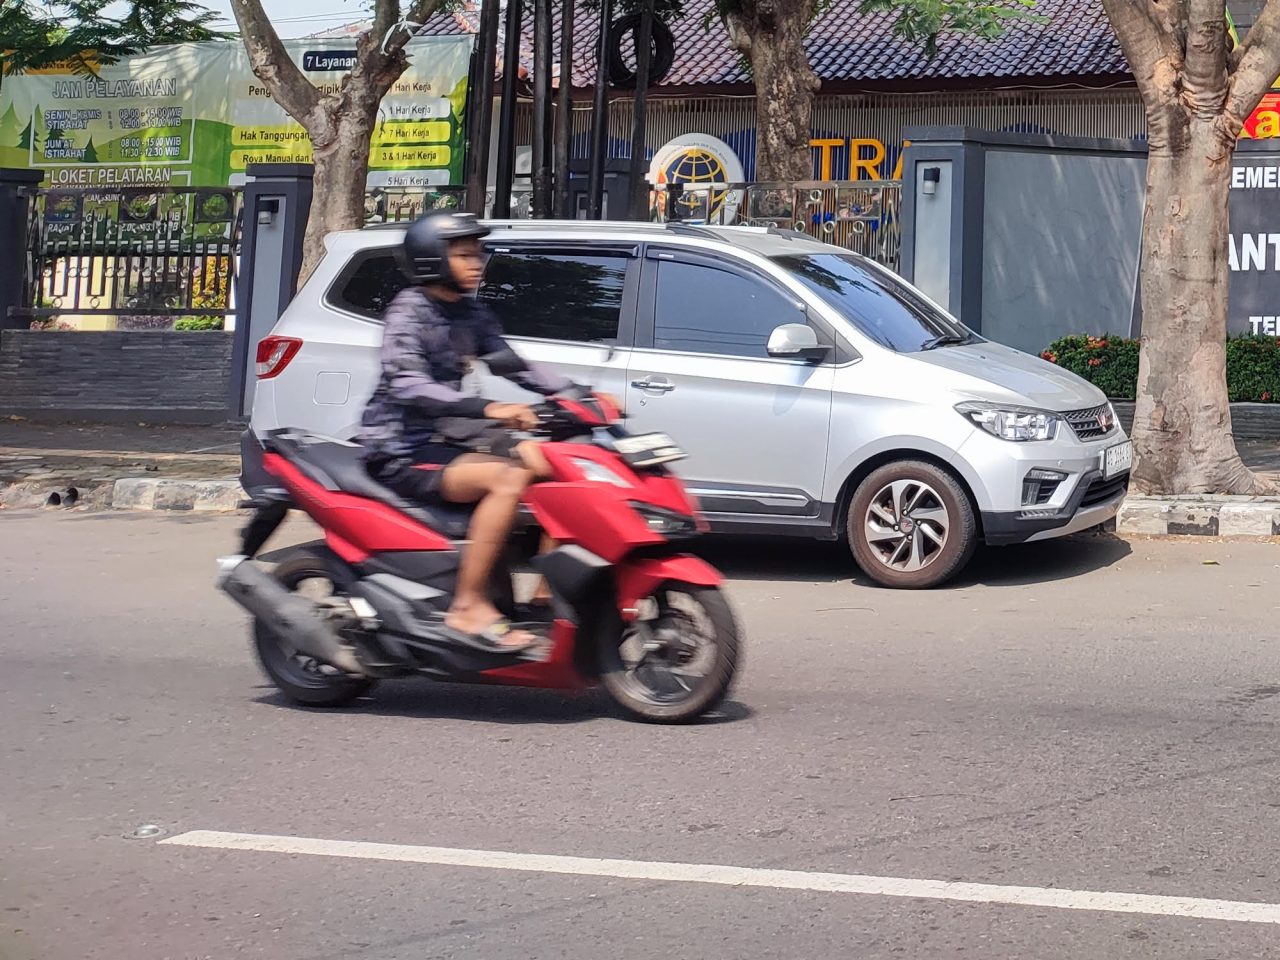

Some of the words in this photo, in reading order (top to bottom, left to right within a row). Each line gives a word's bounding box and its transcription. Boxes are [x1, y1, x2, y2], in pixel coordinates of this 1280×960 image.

[306, 56, 314, 68] 7
[315, 56, 358, 70] Layanan
[52, 80, 82, 99] JAM
[86, 78, 177, 98] PELAYANAN
[395, 83, 410, 92] Hari
[413, 82, 432, 92] Kerja
[45, 110, 71, 120] SENIN
[396, 107, 411, 115] Hari
[412, 105, 431, 116] Kerja
[165, 136, 182, 147] WIB
[240, 131, 257, 141] Hak
[259, 130, 310, 143] Tanggungan
[395, 129, 411, 137] Hari
[412, 128, 430, 138] Kerja
[44, 149, 87, 159] ISTIRAHAT
[121, 148, 139, 158] 11.30
[145, 146, 163, 157] 12.30
[165, 146, 181, 156] WIB
[265, 153, 293, 163] Manual
[295, 153, 309, 162] dan
[402, 152, 416, 160] Hari
[417, 151, 437, 161] Kerja
[51, 169, 95, 184] LOKET
[98, 167, 171, 183] PELATARAN
[394, 177, 411, 185] Hari
[412, 176, 429, 186] Kerja
